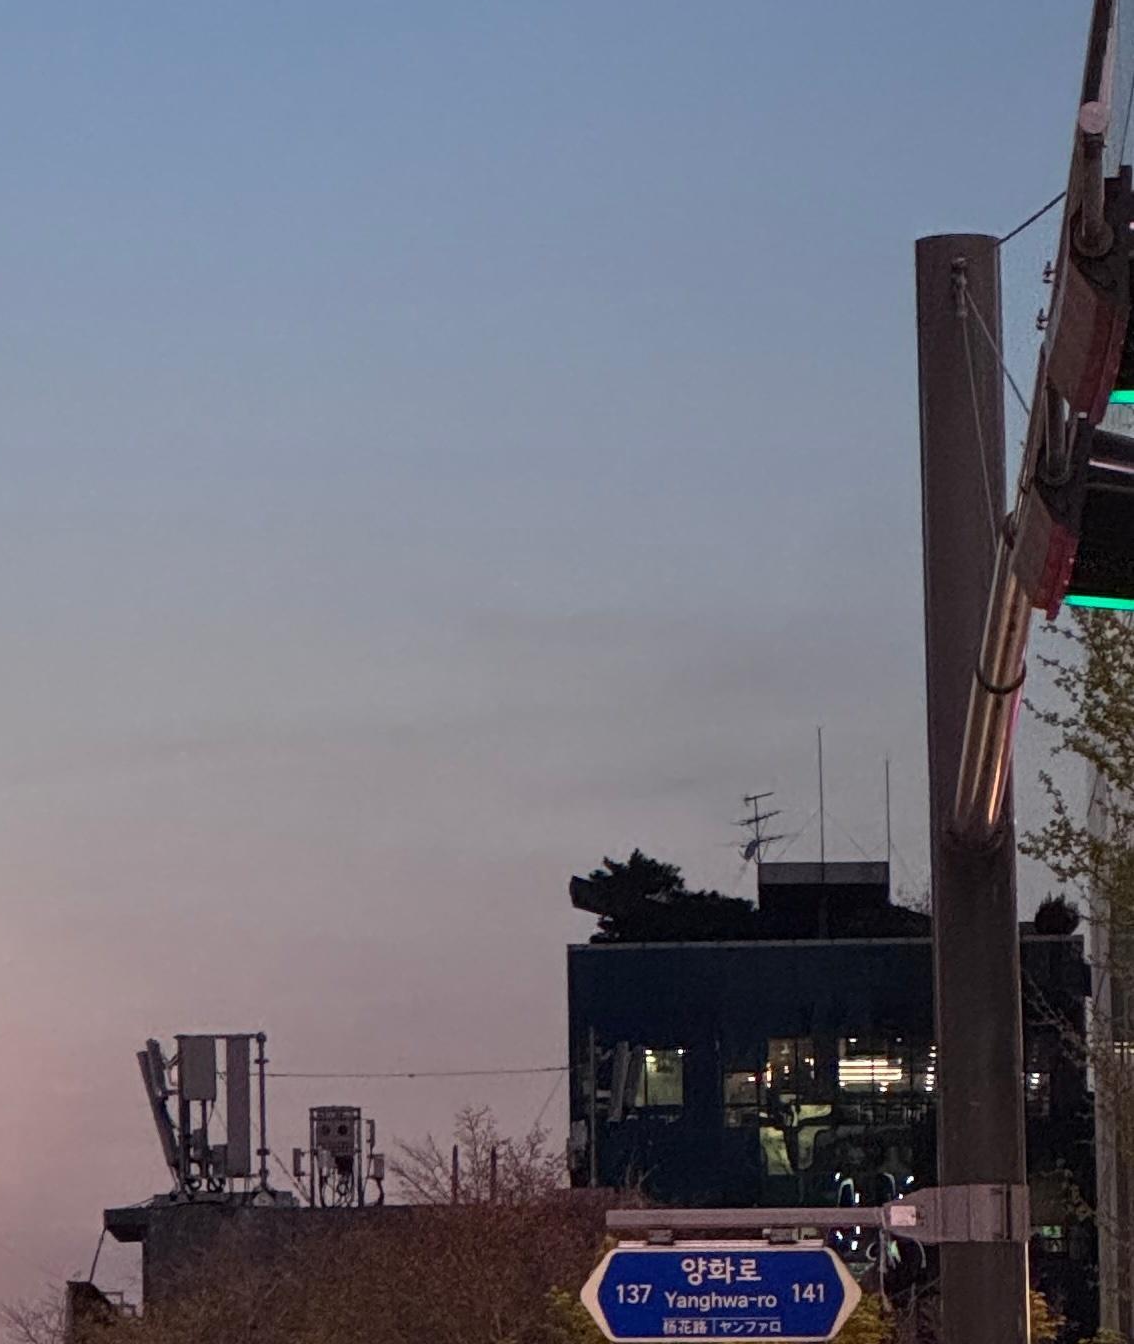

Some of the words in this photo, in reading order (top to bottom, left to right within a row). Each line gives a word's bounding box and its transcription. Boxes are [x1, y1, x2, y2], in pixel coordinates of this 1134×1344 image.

[681, 1257, 762, 1286] 양화로
[616, 1284, 652, 1304] 137
[664, 1291, 777, 1312] Yanghwa-ro
[792, 1283, 825, 1303] 141
[720, 1320, 781, 1333] ヤンファロ
